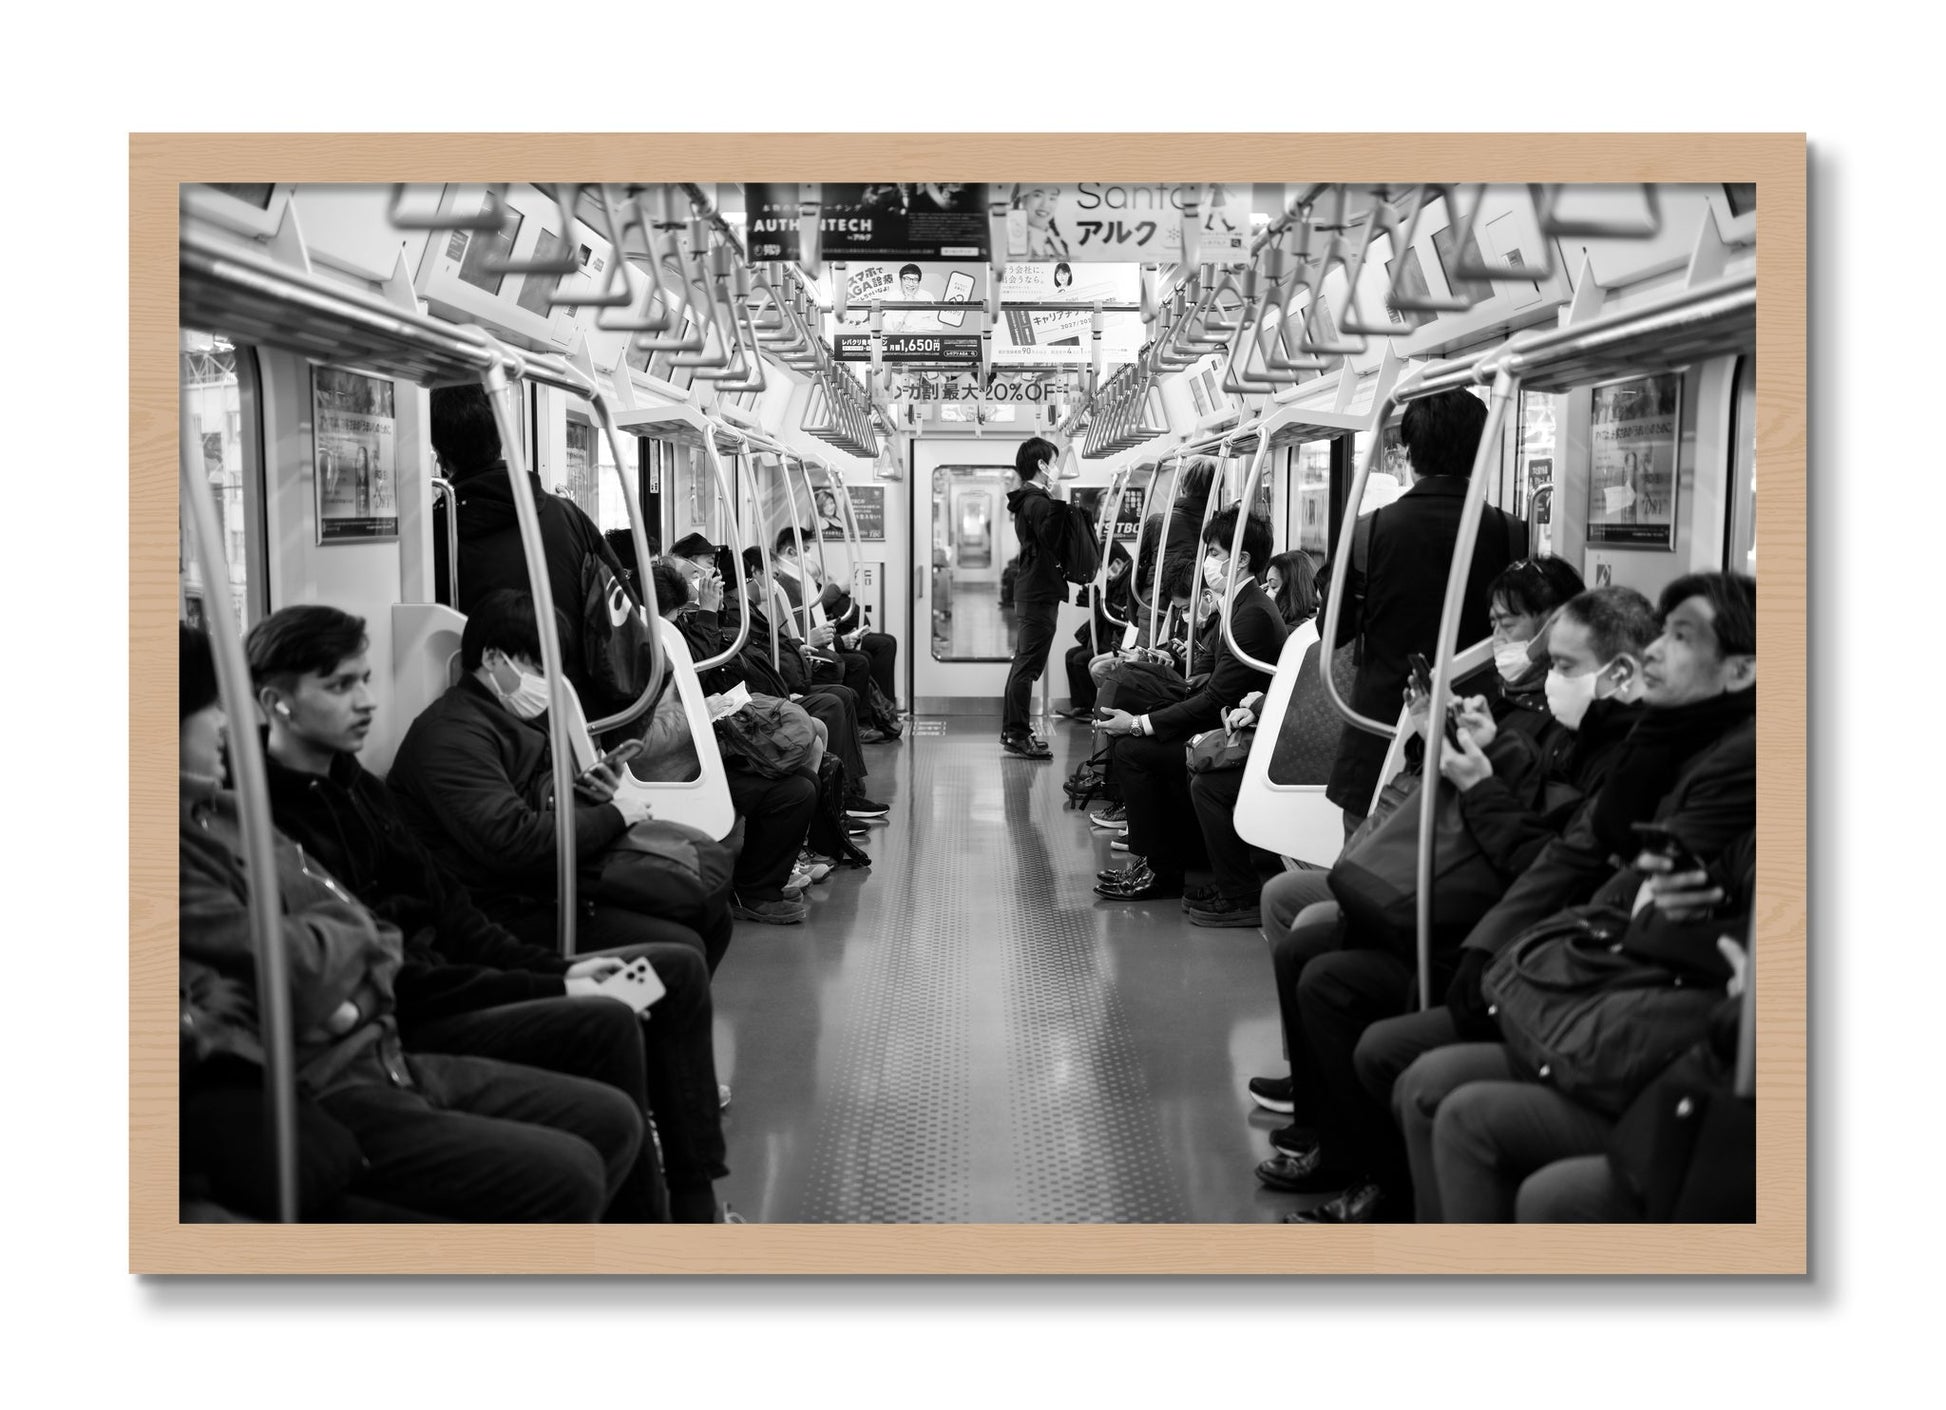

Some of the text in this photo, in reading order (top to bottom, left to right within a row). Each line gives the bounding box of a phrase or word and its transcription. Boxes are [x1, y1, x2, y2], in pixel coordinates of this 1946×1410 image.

[754, 218, 873, 232] AUTHNTECH
[1076, 220, 1157, 247] アルク
[1061, 318, 1092, 330] 2027/202
